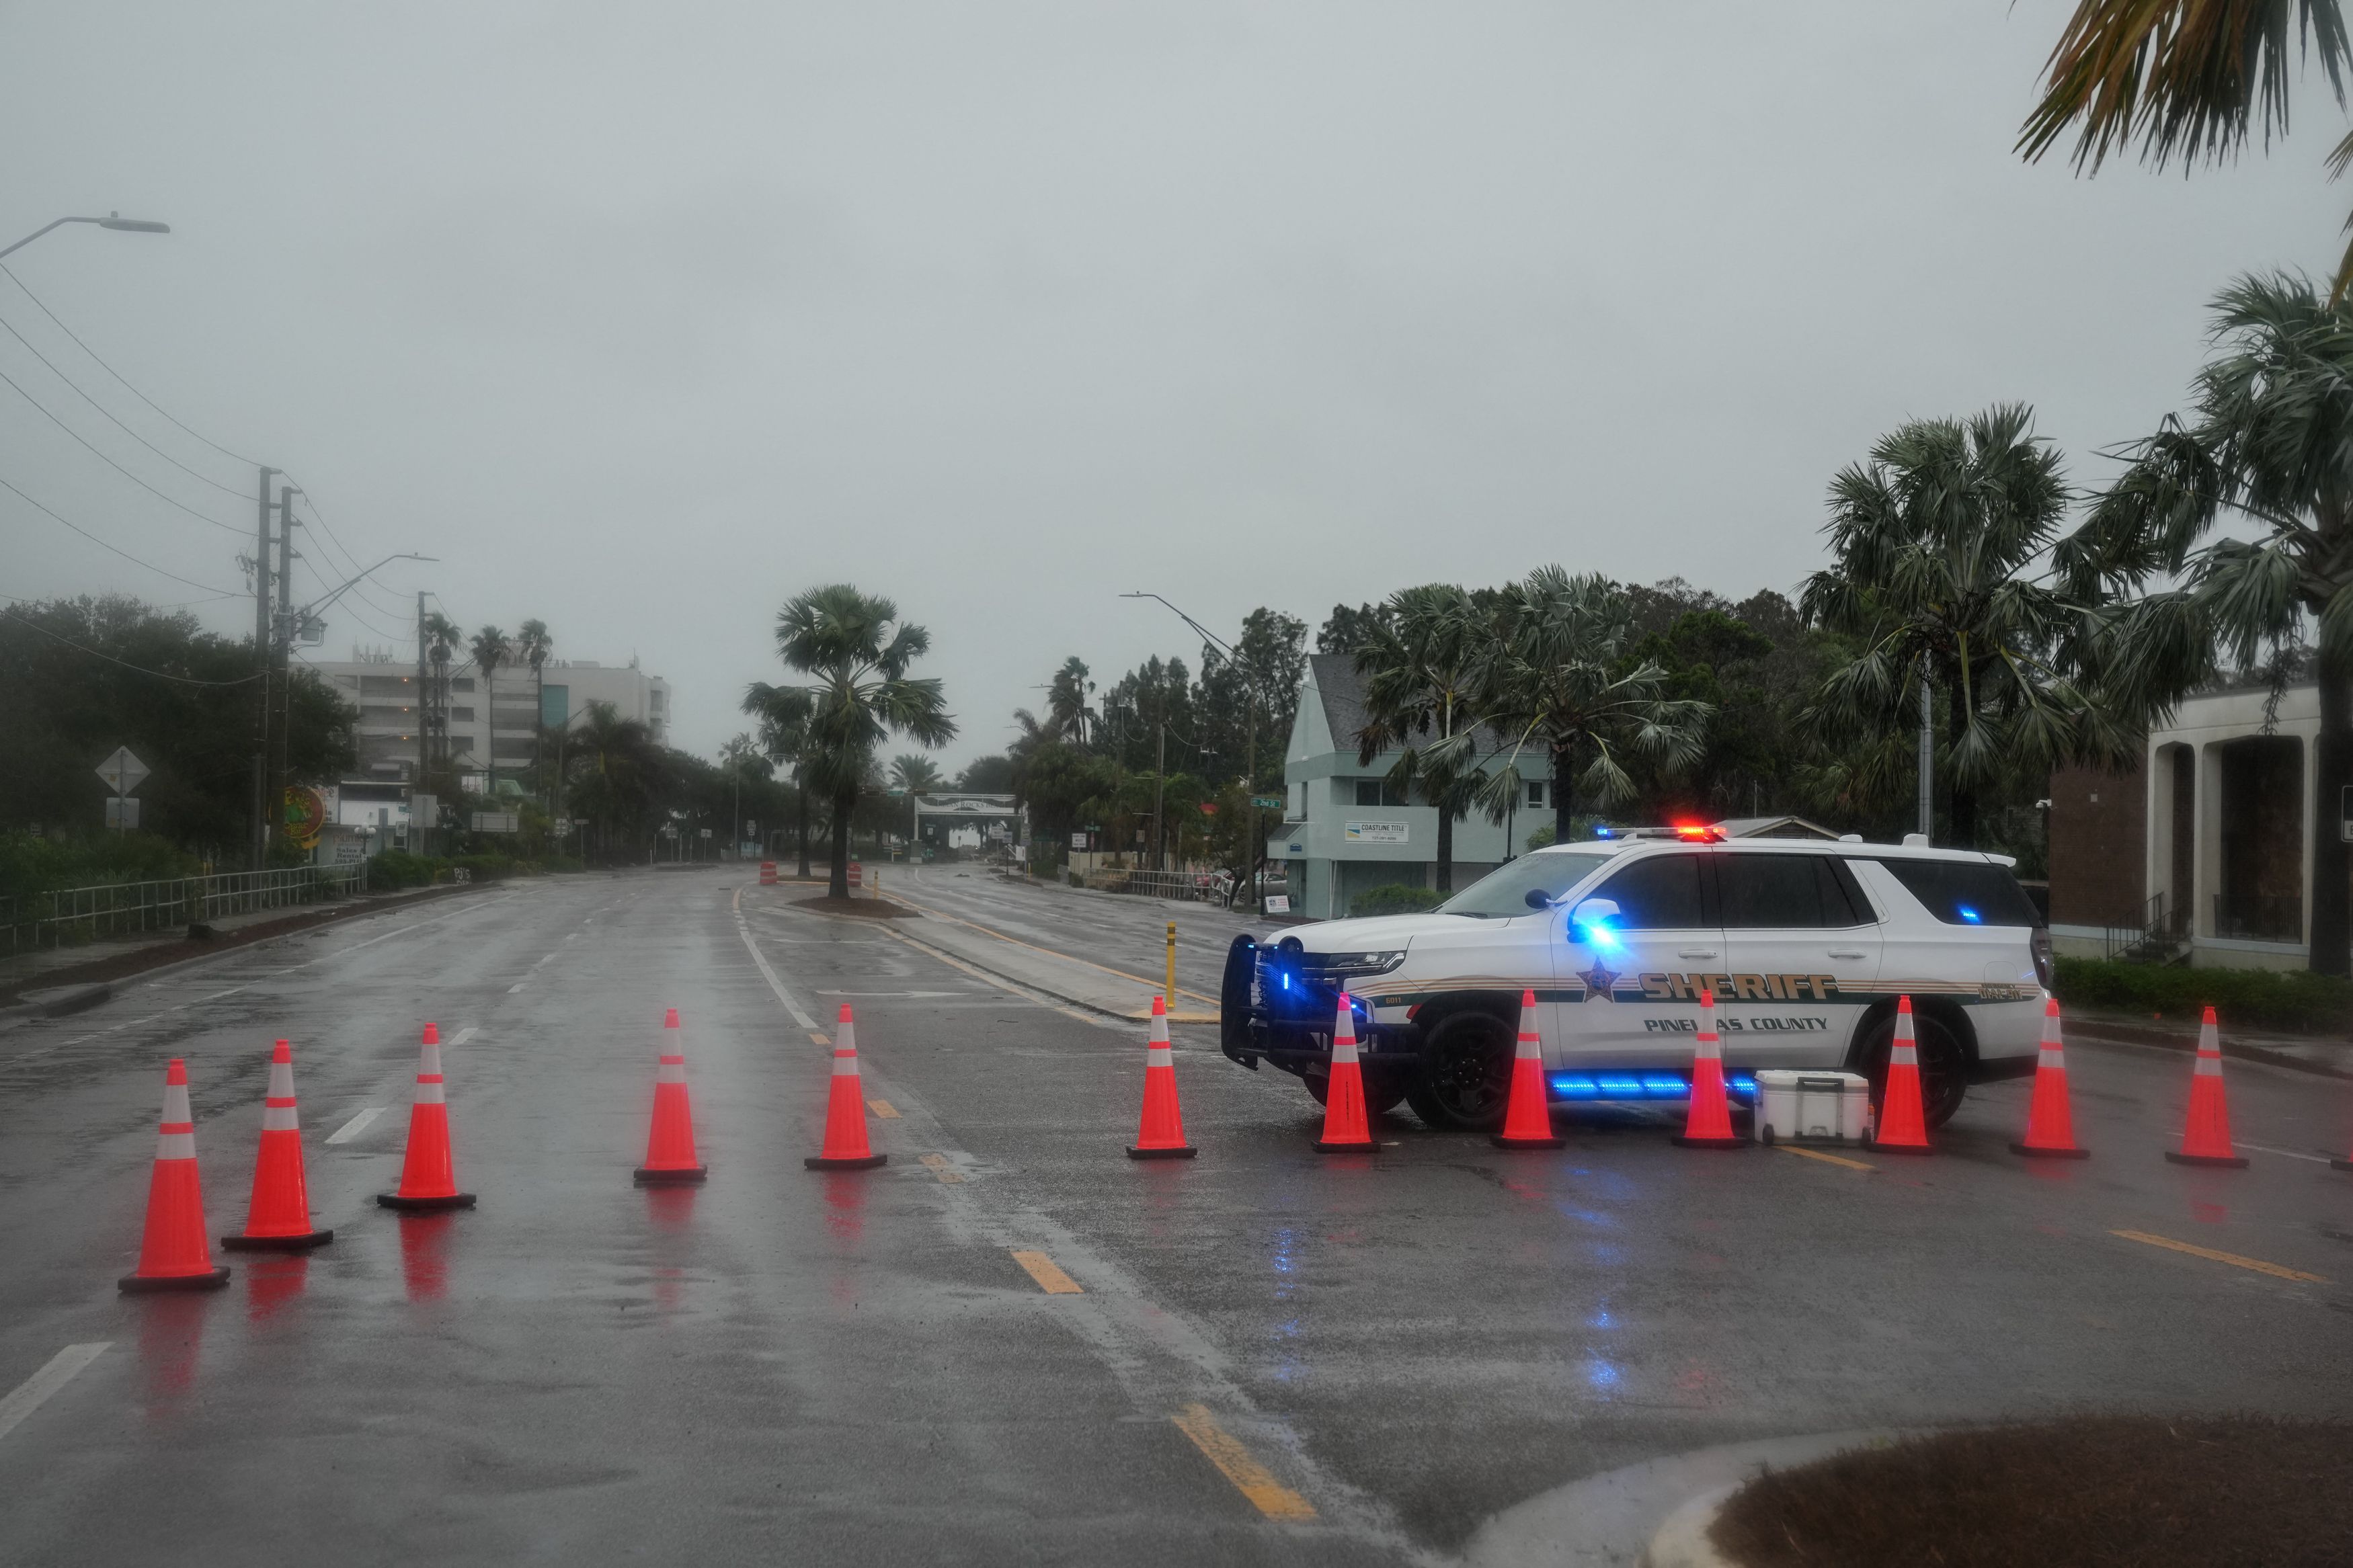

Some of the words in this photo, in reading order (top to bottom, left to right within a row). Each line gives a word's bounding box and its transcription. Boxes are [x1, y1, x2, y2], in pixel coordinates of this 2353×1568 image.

[1638, 973, 1838, 1000] SHERIFF
[1385, 996, 1402, 1005] 6011
[1750, 1018, 1827, 1030] COUNTY
